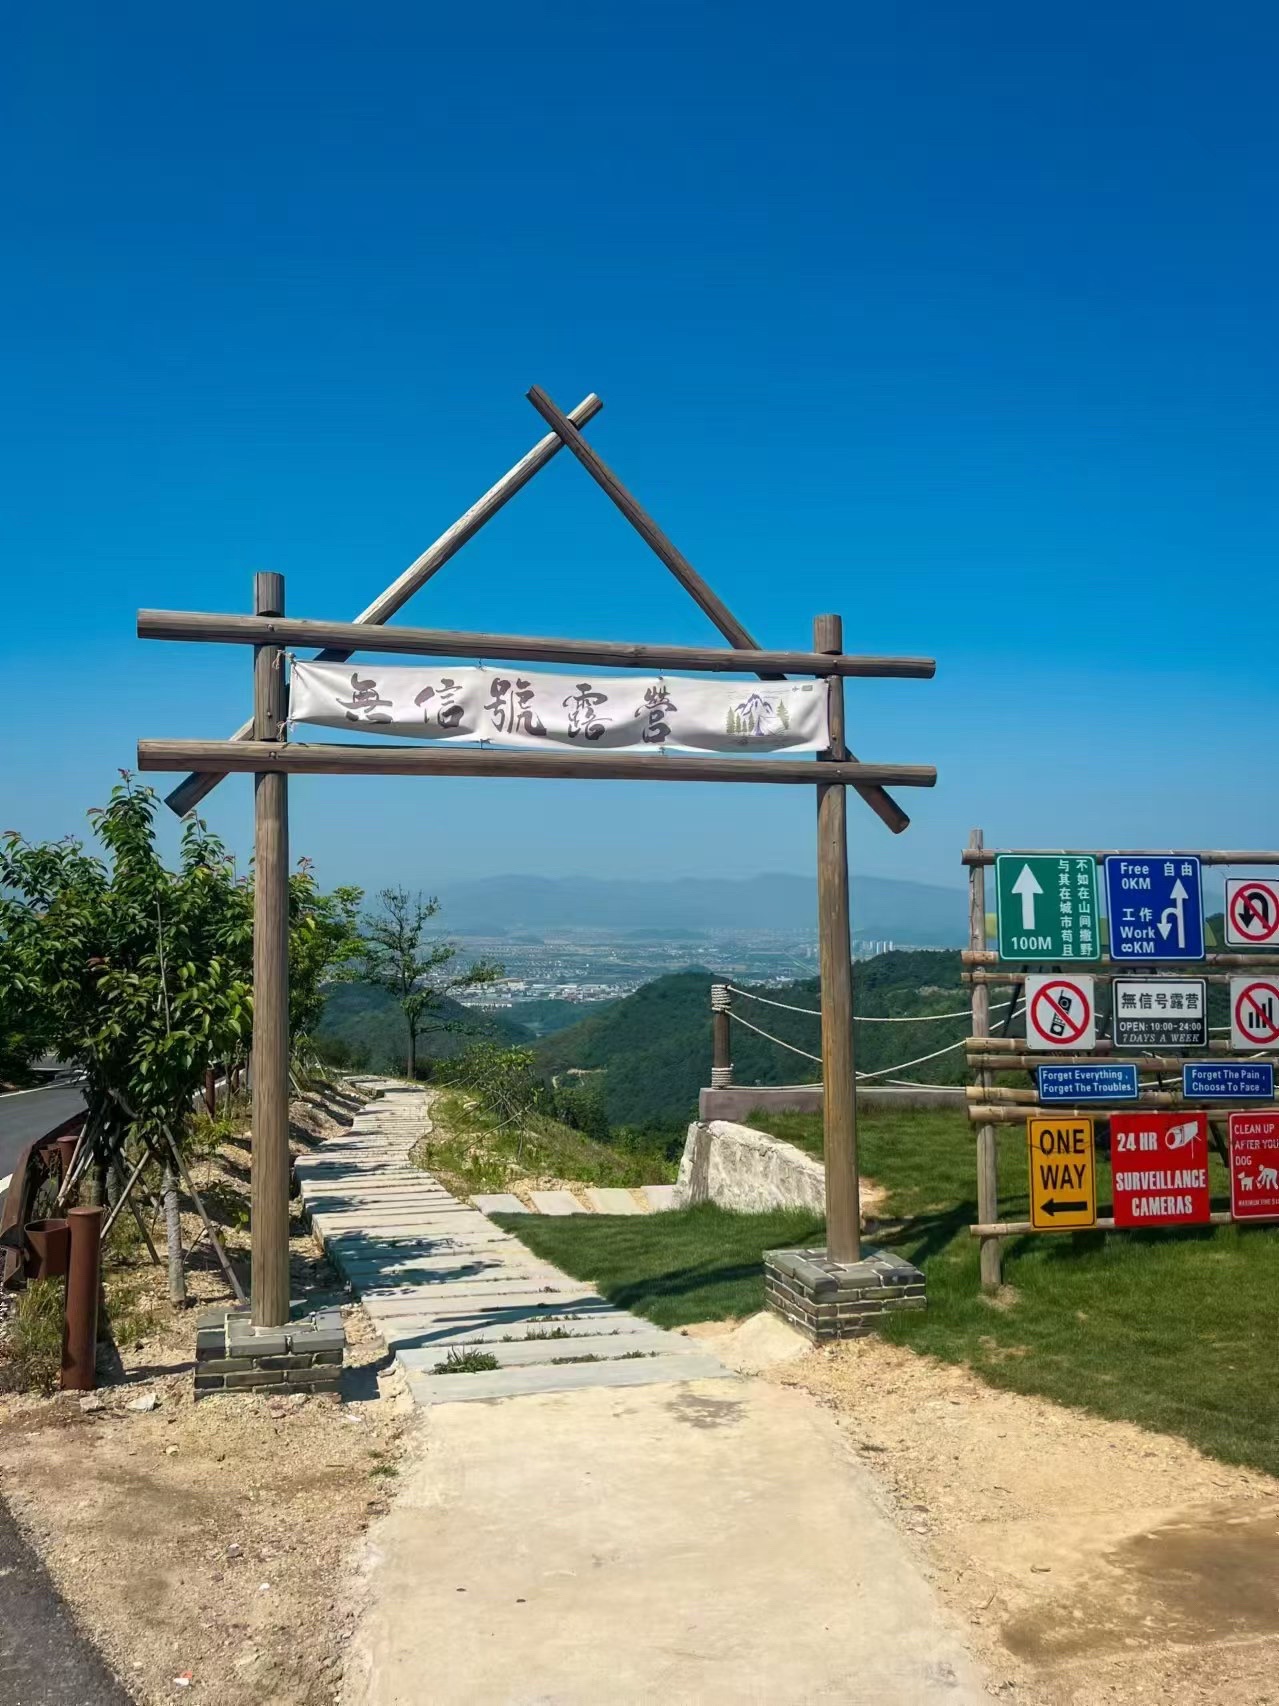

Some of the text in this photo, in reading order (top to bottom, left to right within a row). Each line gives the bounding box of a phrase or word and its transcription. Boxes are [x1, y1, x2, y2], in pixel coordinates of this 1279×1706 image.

[1120, 862, 1150, 875] Free
[1164, 861, 1193, 876] 自由
[1121, 877, 1151, 890] 0KM
[1058, 859, 1074, 957] 与其在城市苟且
[1122, 907, 1153, 922] 工作
[1120, 926, 1156, 939] Work
[1011, 936, 1052, 950] 100M
[1121, 992, 1199, 1010] 無信号露营
[1119, 1021, 1149, 1032] OPEN:
[1129, 1033, 1156, 1043] DAYS
[1159, 1034, 1167, 1042] A
[1171, 1033, 1200, 1042] WEEK
[1042, 1070, 1073, 1081] Forget
[1191, 1069, 1222, 1081] Forget
[1223, 1069, 1239, 1079] The
[1043, 1082, 1134, 1095] Forget The Troubles.
[1192, 1081, 1225, 1092] Choose
[1226, 1081, 1238, 1092] To
[1234, 1123, 1275, 1135] CLEAN UP
[1039, 1129, 1085, 1155] ONE
[1116, 1131, 1158, 1152] 24 HR
[1234, 1138, 1279, 1150] AFTER YOU
[1235, 1155, 1252, 1166] DOG
[1039, 1164, 1086, 1190] WAY
[1115, 1169, 1206, 1192] SURVEILLANCE
[1131, 1195, 1193, 1217] CAMERAS
